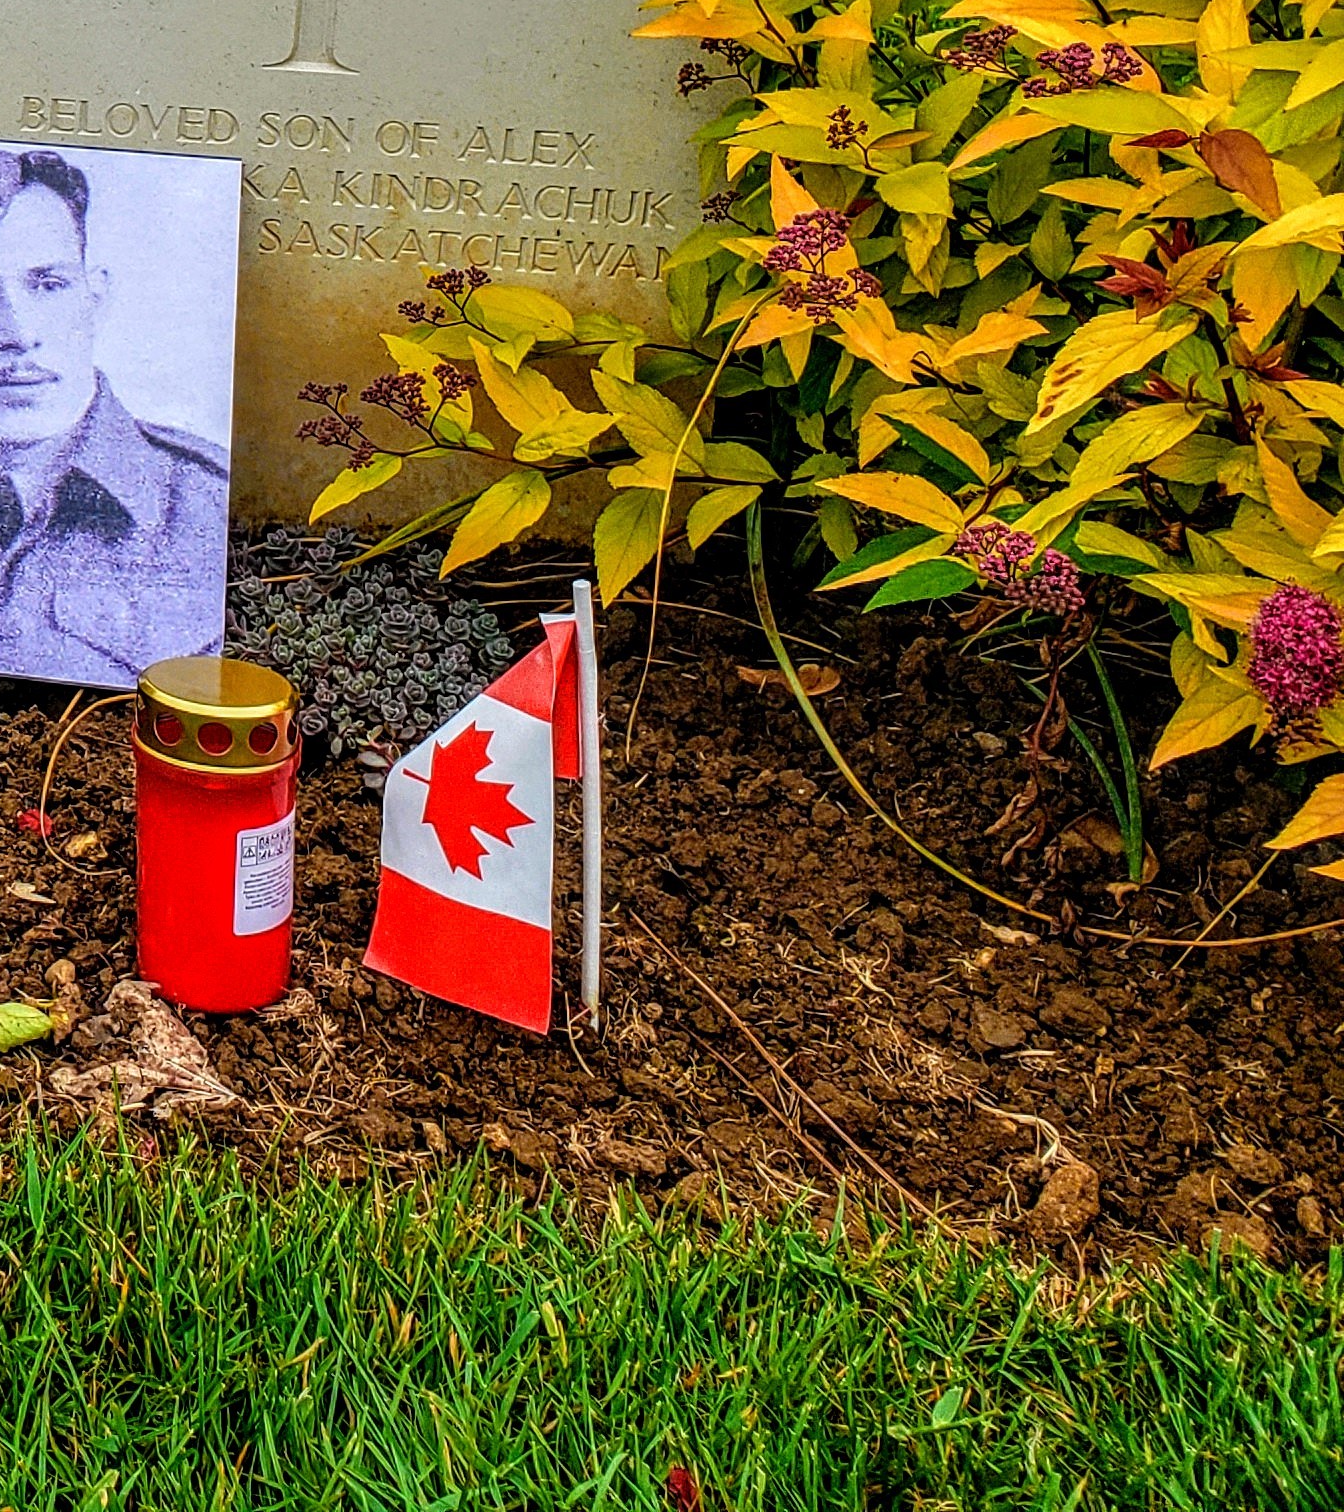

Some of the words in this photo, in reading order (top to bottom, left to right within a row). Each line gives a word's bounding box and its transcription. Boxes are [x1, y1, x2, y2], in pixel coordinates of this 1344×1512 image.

[18, 95, 241, 146] BELOVED
[256, 112, 356, 154] SON
[375, 120, 441, 159] OF
[456, 125, 599, 171] ALEX
[331, 170, 676, 232] KINDRACHUK
